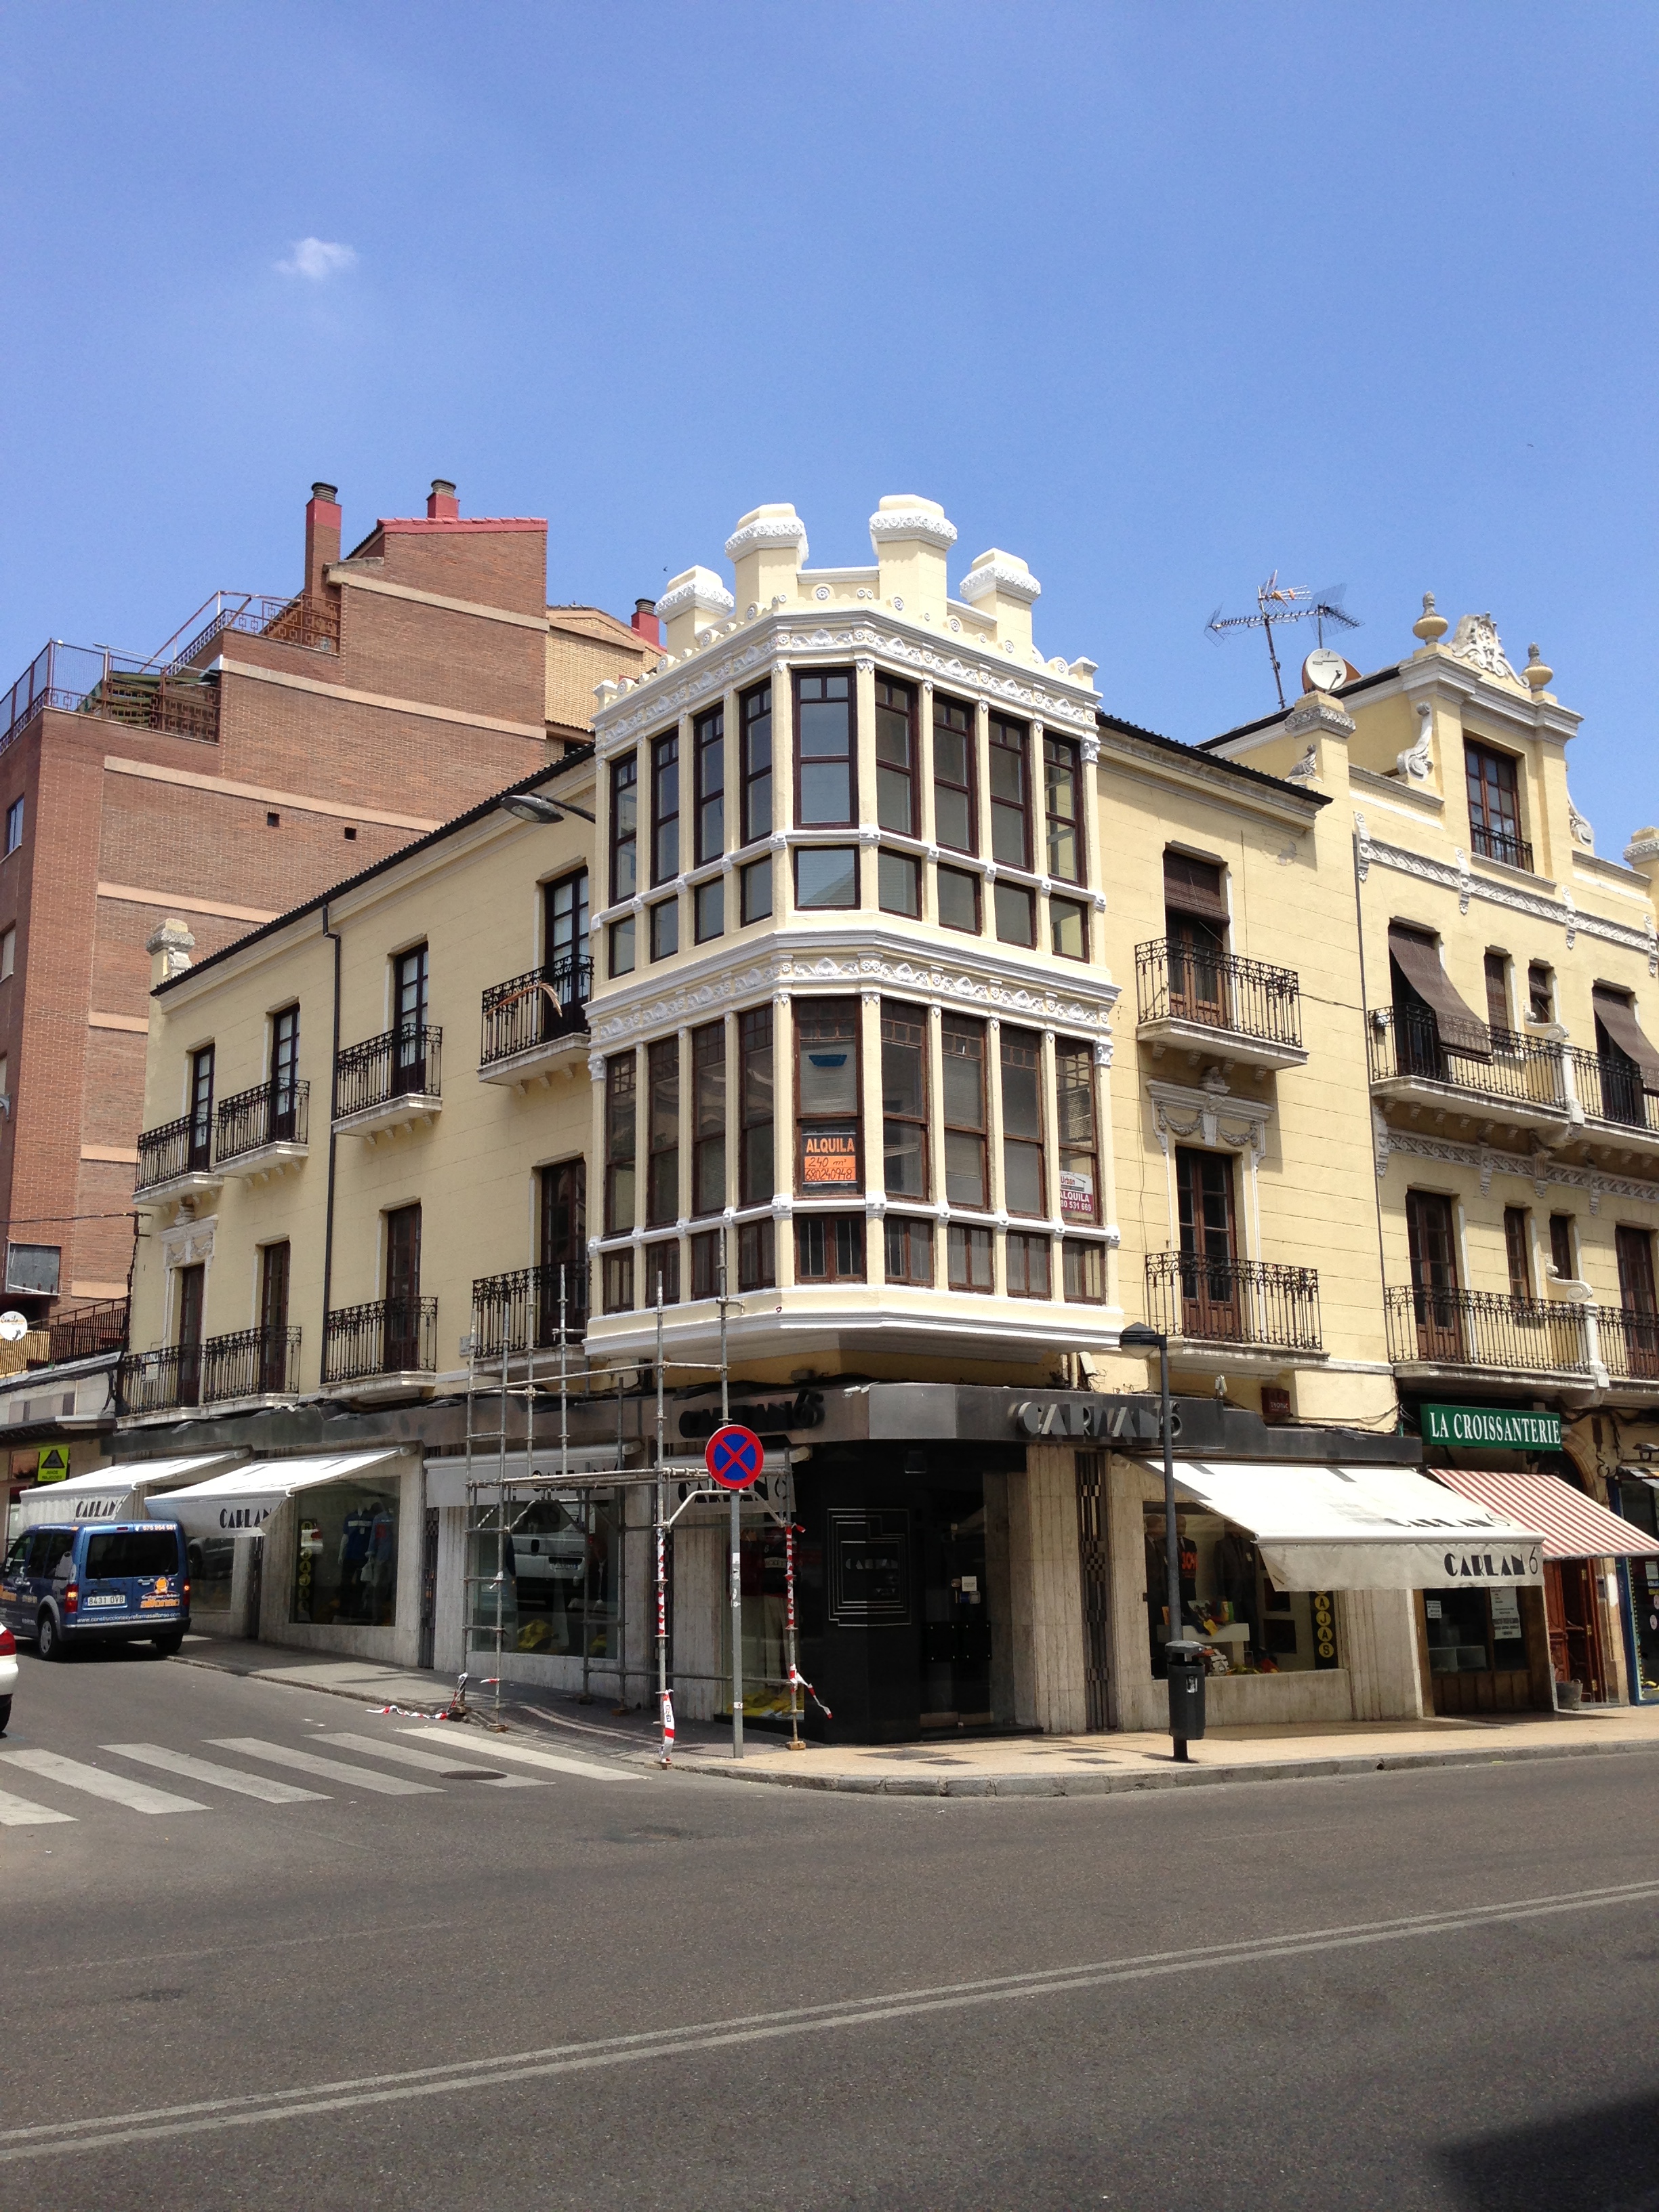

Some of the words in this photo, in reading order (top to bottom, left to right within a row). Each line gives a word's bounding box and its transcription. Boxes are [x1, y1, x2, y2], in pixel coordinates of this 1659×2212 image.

[806, 1137, 855, 1153] ALQUILA
[808, 1157, 829, 1168] 240
[805, 1168, 853, 1181] 680240948
[1069, 1201, 1080, 1210] 531
[1081, 1203, 1092, 1212] 669
[1430, 1412, 1450, 1438] LA
[1453, 1413, 1561, 1444] CROISSANTERIE
[1443, 1553, 1525, 1577] CARLAN
[1529, 1547, 1538, 1575] 6
[89, 1597, 107, 1605] 8431
